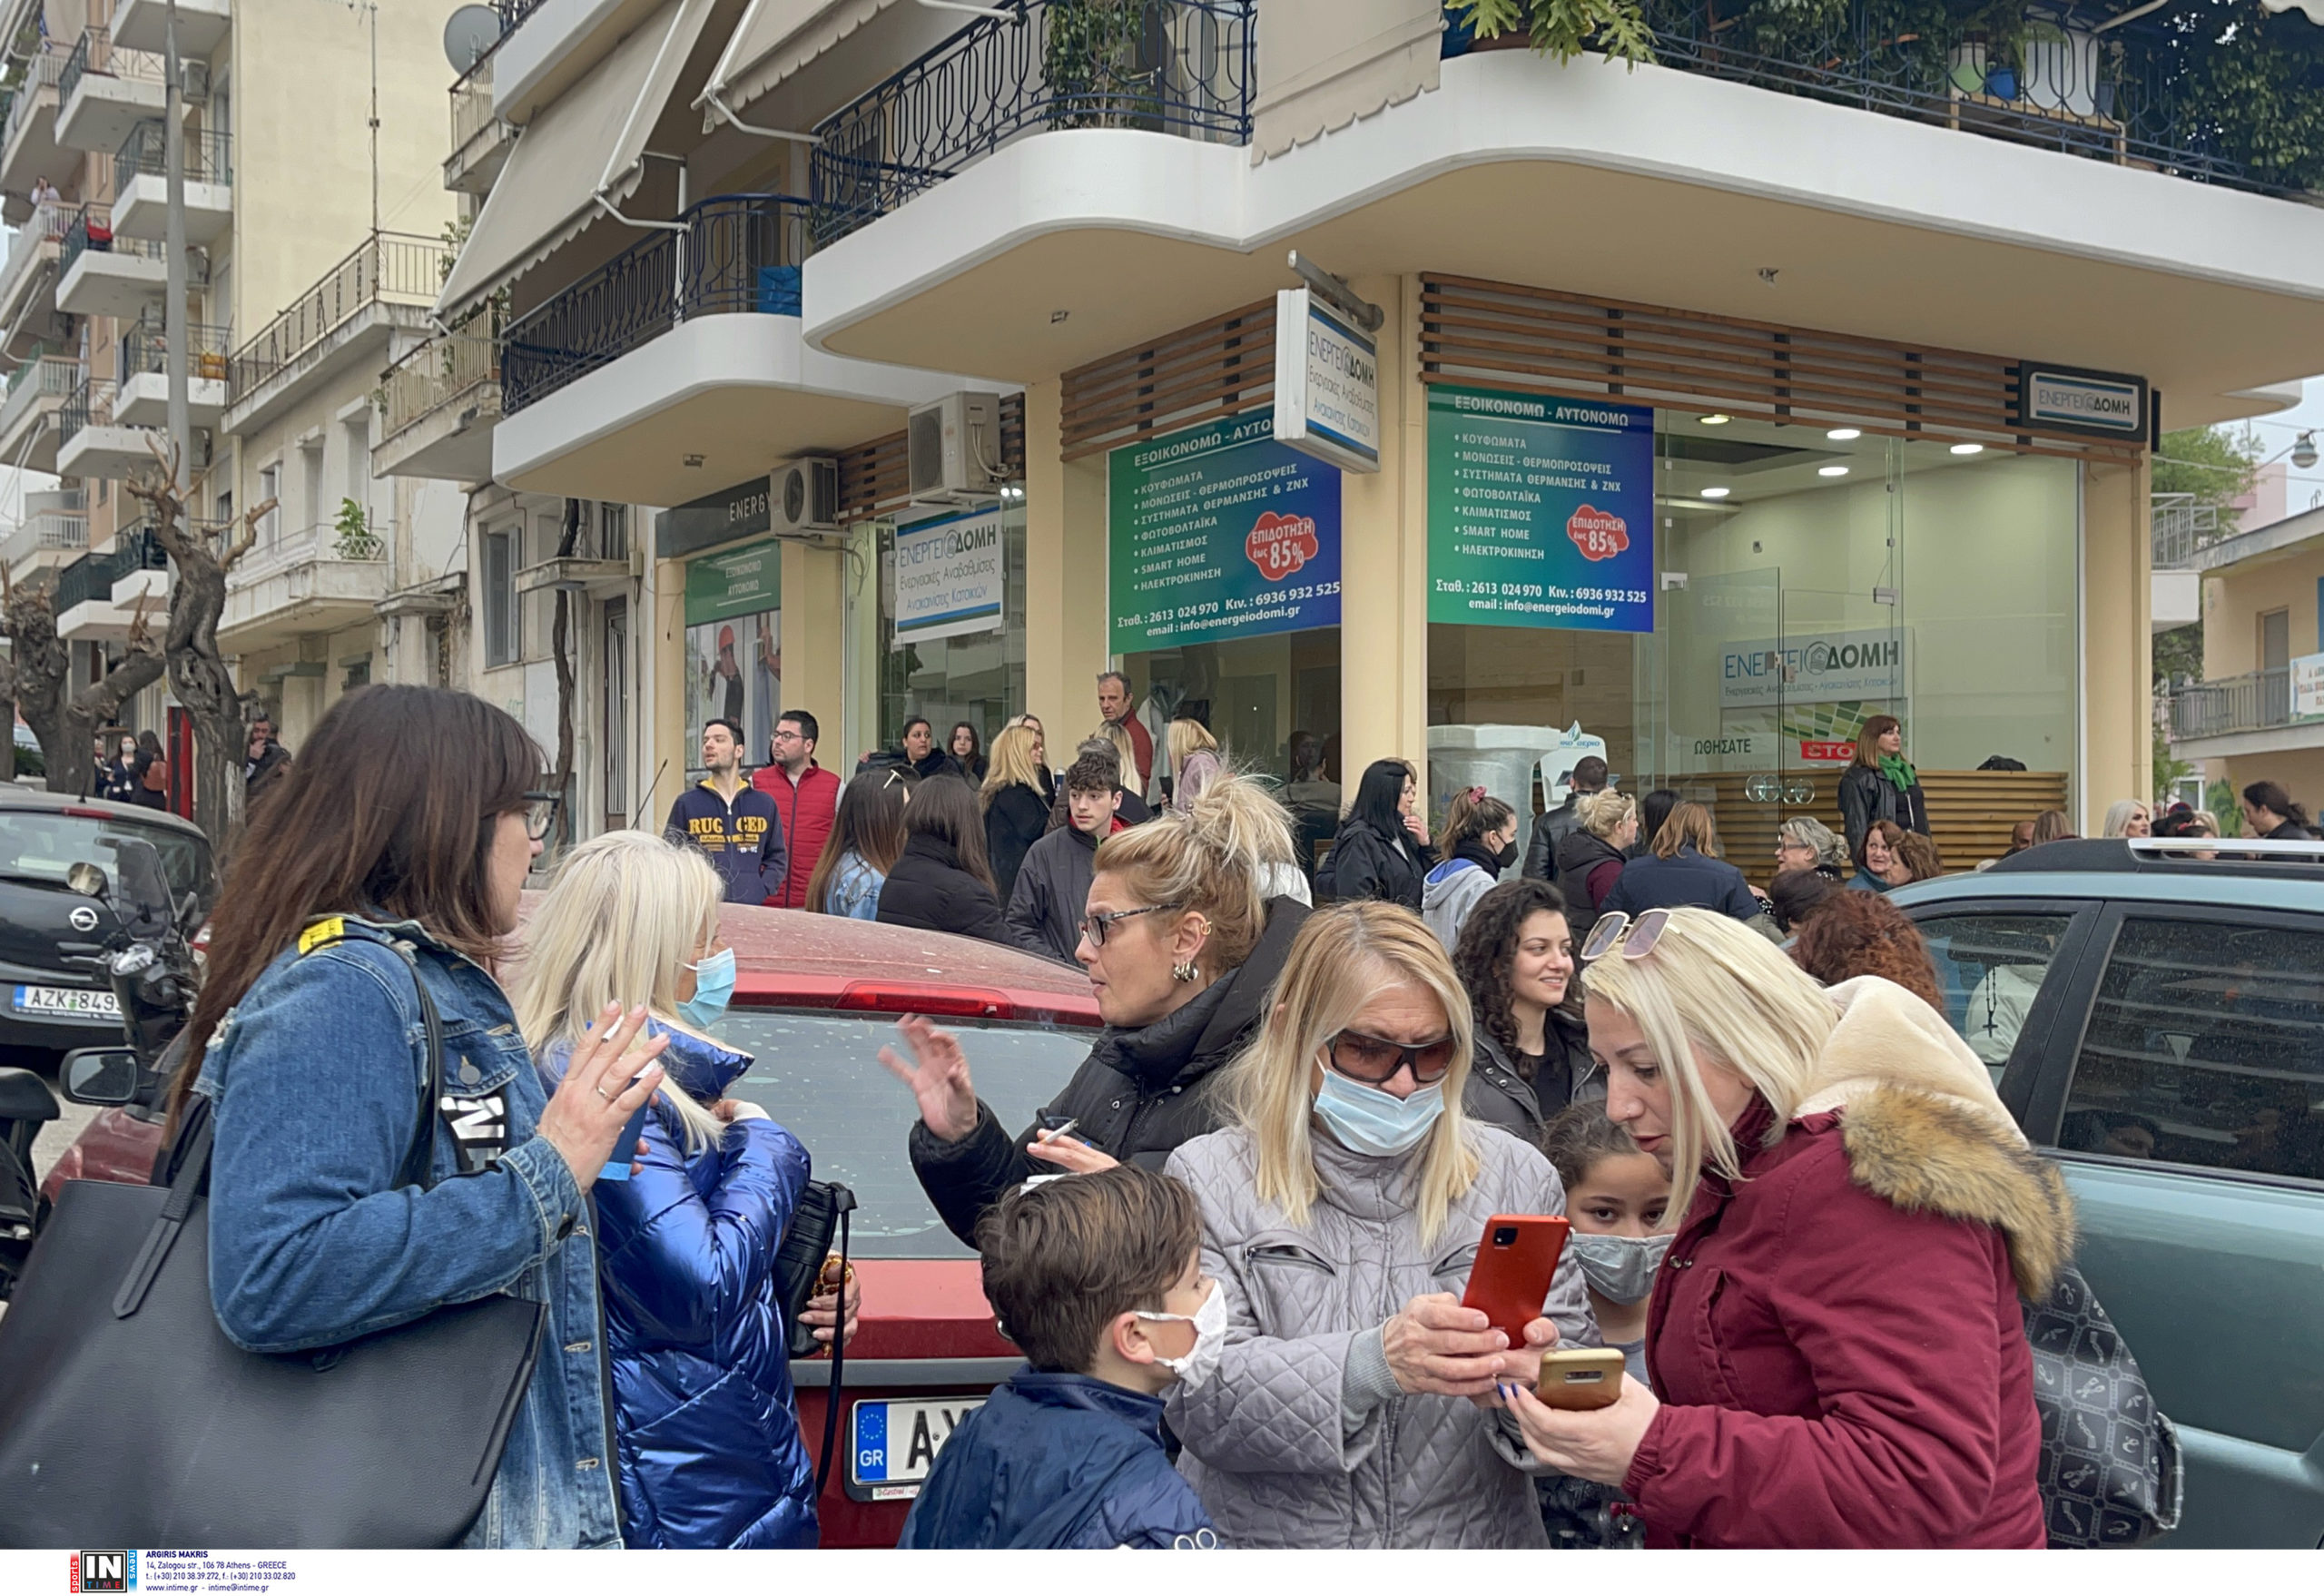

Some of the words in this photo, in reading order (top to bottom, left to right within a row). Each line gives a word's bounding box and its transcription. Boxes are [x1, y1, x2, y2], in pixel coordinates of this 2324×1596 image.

[1455, 395, 1544, 417] ΕΞΟΙΚΟΝΟΜΩ
[1556, 407, 1629, 427] ΑΥΤΟΝΟΜΩ
[1135, 433, 1221, 467] ΕΞΟΙΚΟΝΟΜΩ
[1234, 419, 1275, 439] ΑΥΤΟ
[1462, 434, 1527, 449] ΚΟΥΦΩΜΑΤΑ
[1462, 451, 1514, 466] ΜΟΝΩΣΕΙΣ
[1523, 458, 1611, 475] ΘΕΡΜΟΠΡΟΣΟΨΕΙΣ
[1141, 471, 1203, 495] ΚΟΥΦΩΜΑΤΑ
[1141, 489, 1191, 510] ΜΟΝΩΣΕΙΣ
[1199, 464, 1297, 497] ΘΕΡΜΟΠΡΟΣΟΨΕΙΣ
[1462, 468, 1522, 483] ΣΥΣΤΗΜΑΤΑ
[1527, 474, 1587, 488] ΘΕΡΜΑΝΣΗΣ
[1590, 480, 1598, 491] &
[1602, 482, 1621, 492] ΖΝΧ
[1141, 504, 1198, 525] ΣΥΣΤΗΜΑΤΑ
[1204, 488, 1267, 511] ΘΕΡΜΑΝΣΗΣ
[1273, 485, 1281, 495] &
[1286, 478, 1308, 491] ΖΝΧ
[1462, 488, 1541, 503] ΦΩΤΟΒΟΛΤΑΪΚΑ
[1462, 506, 1531, 521] ΚΛΙΜΑΤΙΣΜΟΣ
[1572, 517, 1625, 530] ΕΠΙΔΟΤΗΣΗ
[1141, 517, 1217, 540] ΦΩΤΟΒΟΛΤΑΪΚΑ
[1251, 520, 1312, 545] ΕΠΙΔΟΤΗΣΗ
[1462, 526, 1495, 537] SMART
[1501, 528, 1530, 540] HOME
[1141, 536, 1207, 557] ΚΛΙΜΑΤΙΣΜΟΣ
[1462, 545, 1544, 560] ΗΛΕΚΤΡΟΚΙΝΗΣΗ
[1589, 530, 1618, 553] 85%
[1141, 561, 1173, 575] SMART
[1177, 554, 1206, 567] HOME
[1270, 540, 1304, 569] 85%
[1141, 568, 1222, 591] ΗΛΕΚΤΡΟΚΙΝΗΣΗ
[1149, 609, 1173, 623] 2613
[1177, 605, 1196, 618] 024
[1198, 602, 1218, 615] 970
[1256, 590, 1286, 606] 6936
[1289, 586, 1313, 601] 932
[1316, 581, 1341, 596] 525
[1472, 581, 1497, 595] 2613
[1502, 583, 1521, 595] 024
[1523, 584, 1542, 596] 970
[1576, 588, 1602, 601] 6936
[1605, 589, 1625, 601] 932
[1627, 590, 1647, 603] 525
[1180, 605, 1301, 632] info@energeiodomi.gr
[1504, 599, 1615, 618] info@energeiodomi.gr
[1694, 739, 1751, 755] ΩΘΗΣΑΤΕ
[861, 1449, 883, 1466] GR
